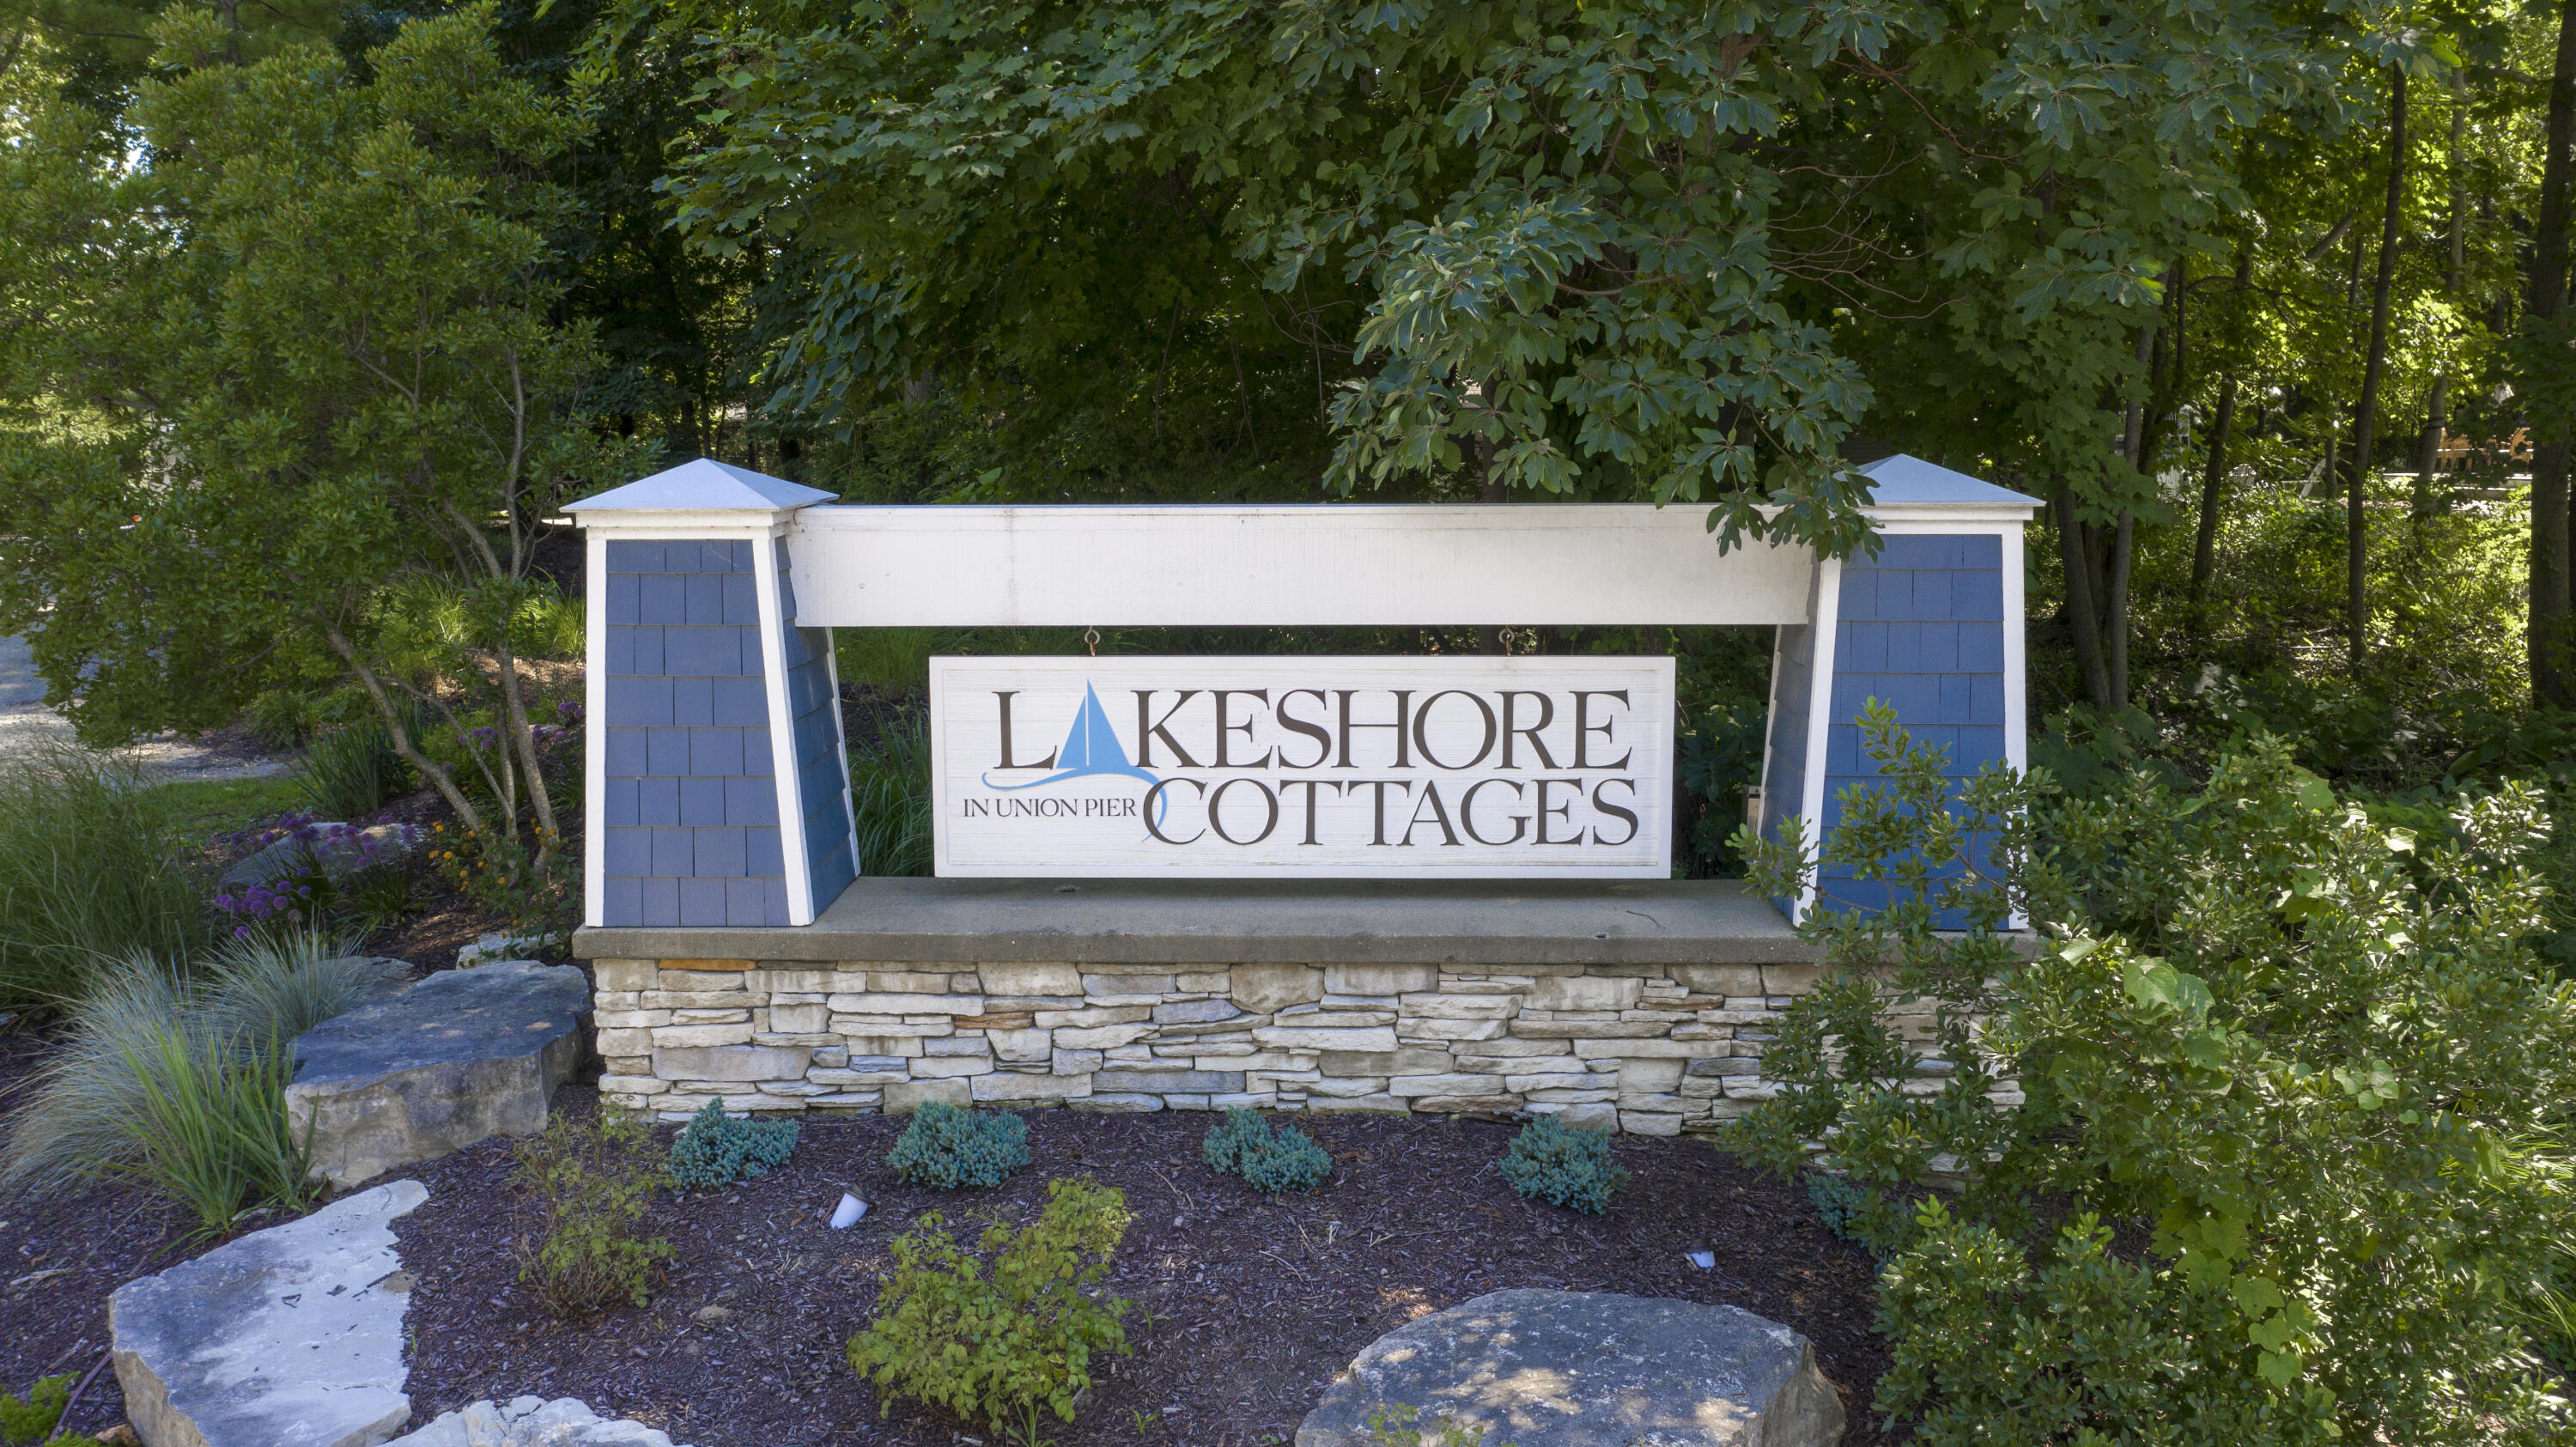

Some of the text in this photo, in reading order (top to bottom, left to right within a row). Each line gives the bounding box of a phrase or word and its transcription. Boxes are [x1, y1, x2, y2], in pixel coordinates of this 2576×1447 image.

[963, 798, 1137, 818] IN UNION PIER
[1143, 777, 1638, 846] COTTAGES
